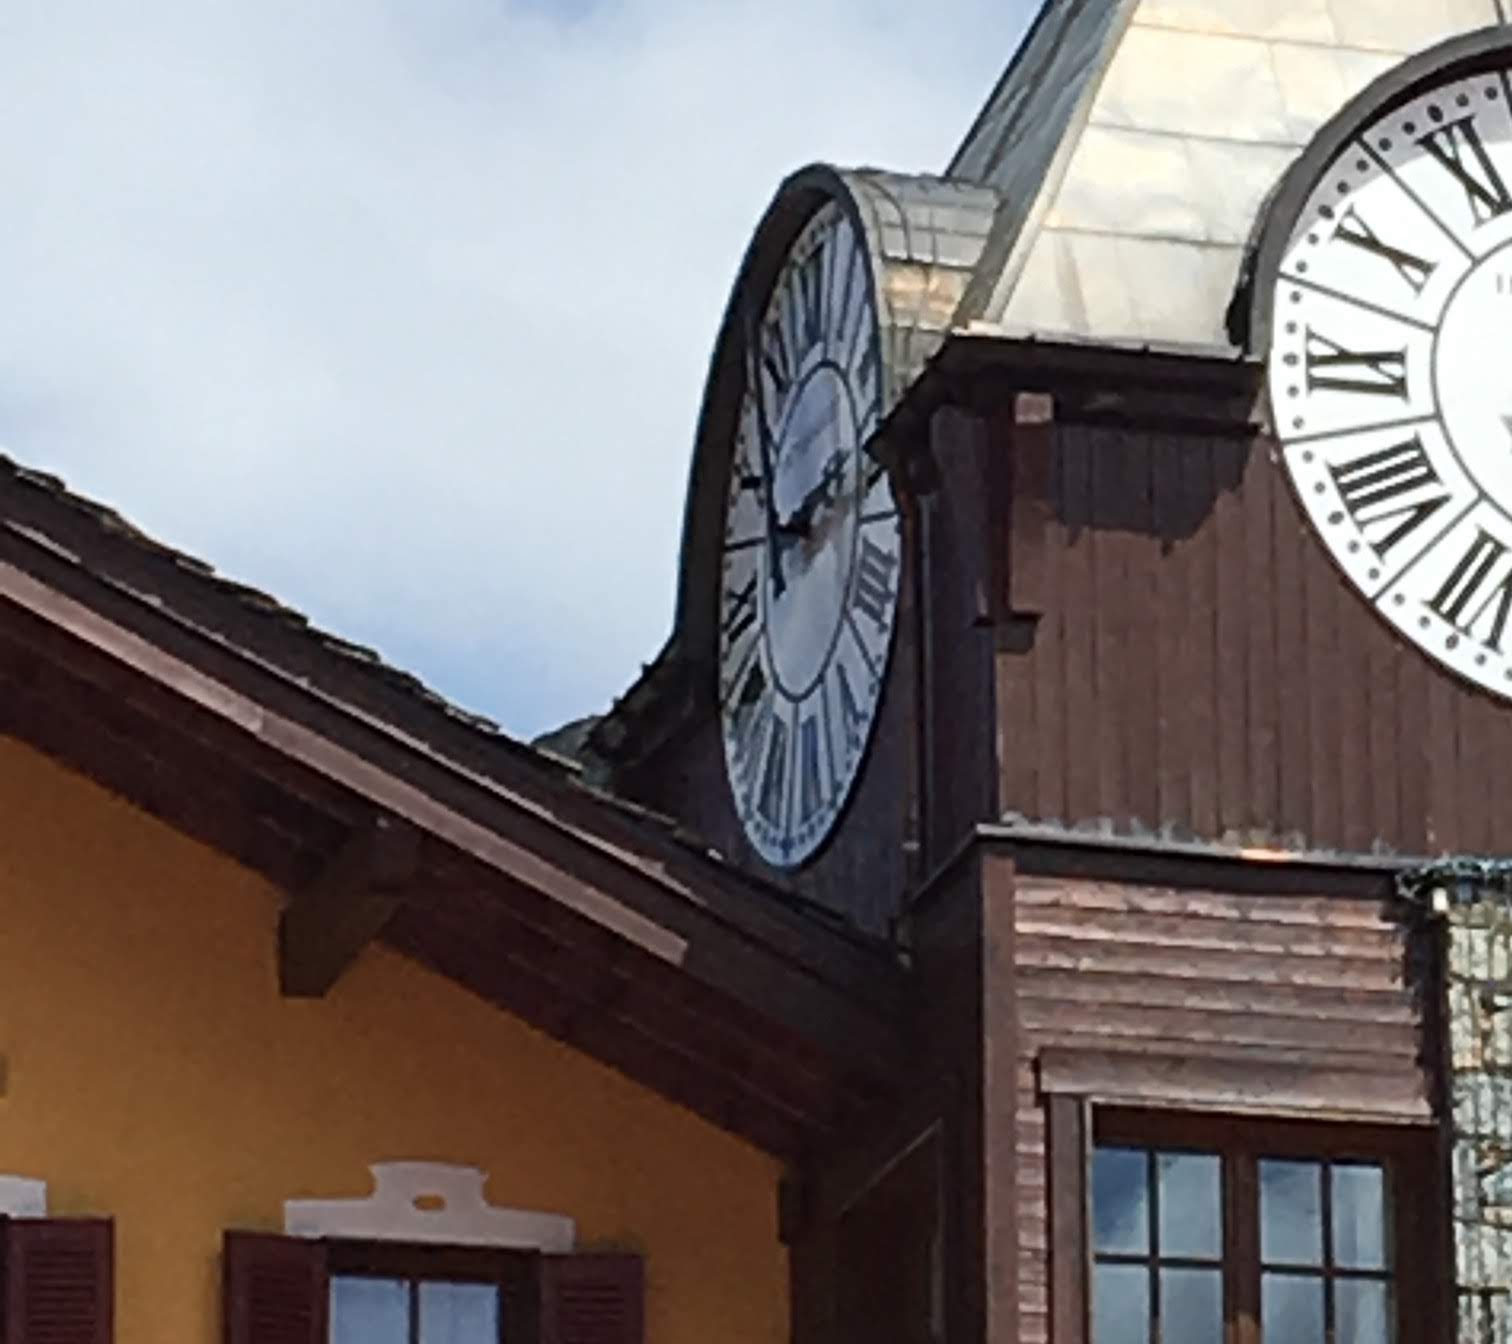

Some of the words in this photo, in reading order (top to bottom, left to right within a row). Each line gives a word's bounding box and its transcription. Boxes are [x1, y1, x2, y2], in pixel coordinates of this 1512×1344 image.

[1331, 202, 1439, 299] X
[1304, 323, 1411, 405] IX
[1325, 430, 1453, 565] VIII
